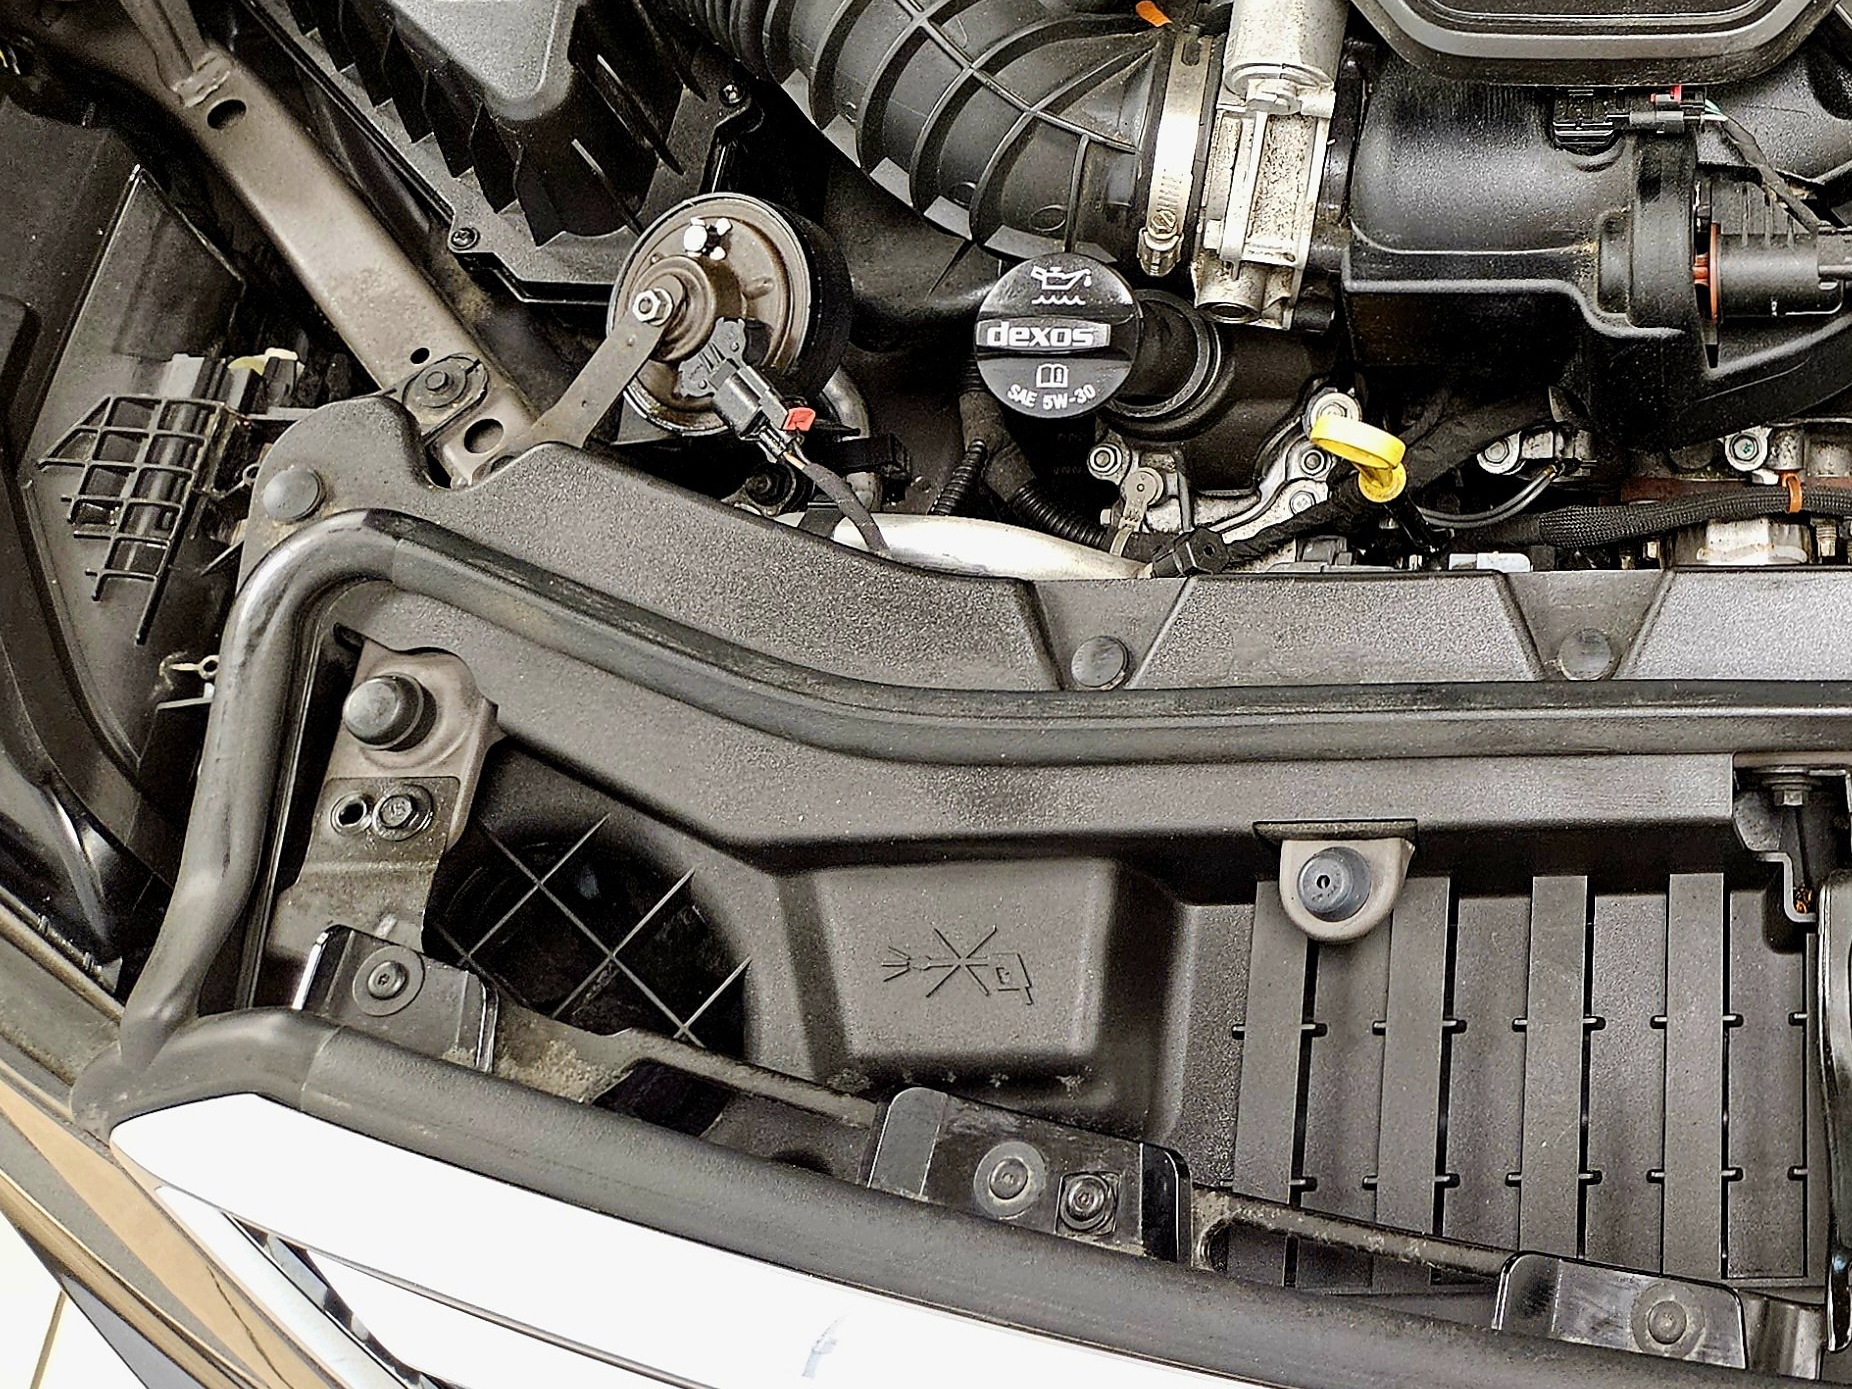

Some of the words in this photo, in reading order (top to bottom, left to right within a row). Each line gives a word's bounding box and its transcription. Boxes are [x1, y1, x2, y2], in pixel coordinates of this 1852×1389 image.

[986, 321, 1094, 347] dexos
[1007, 384, 1038, 408] SAE
[1042, 384, 1096, 410] 5W-30
